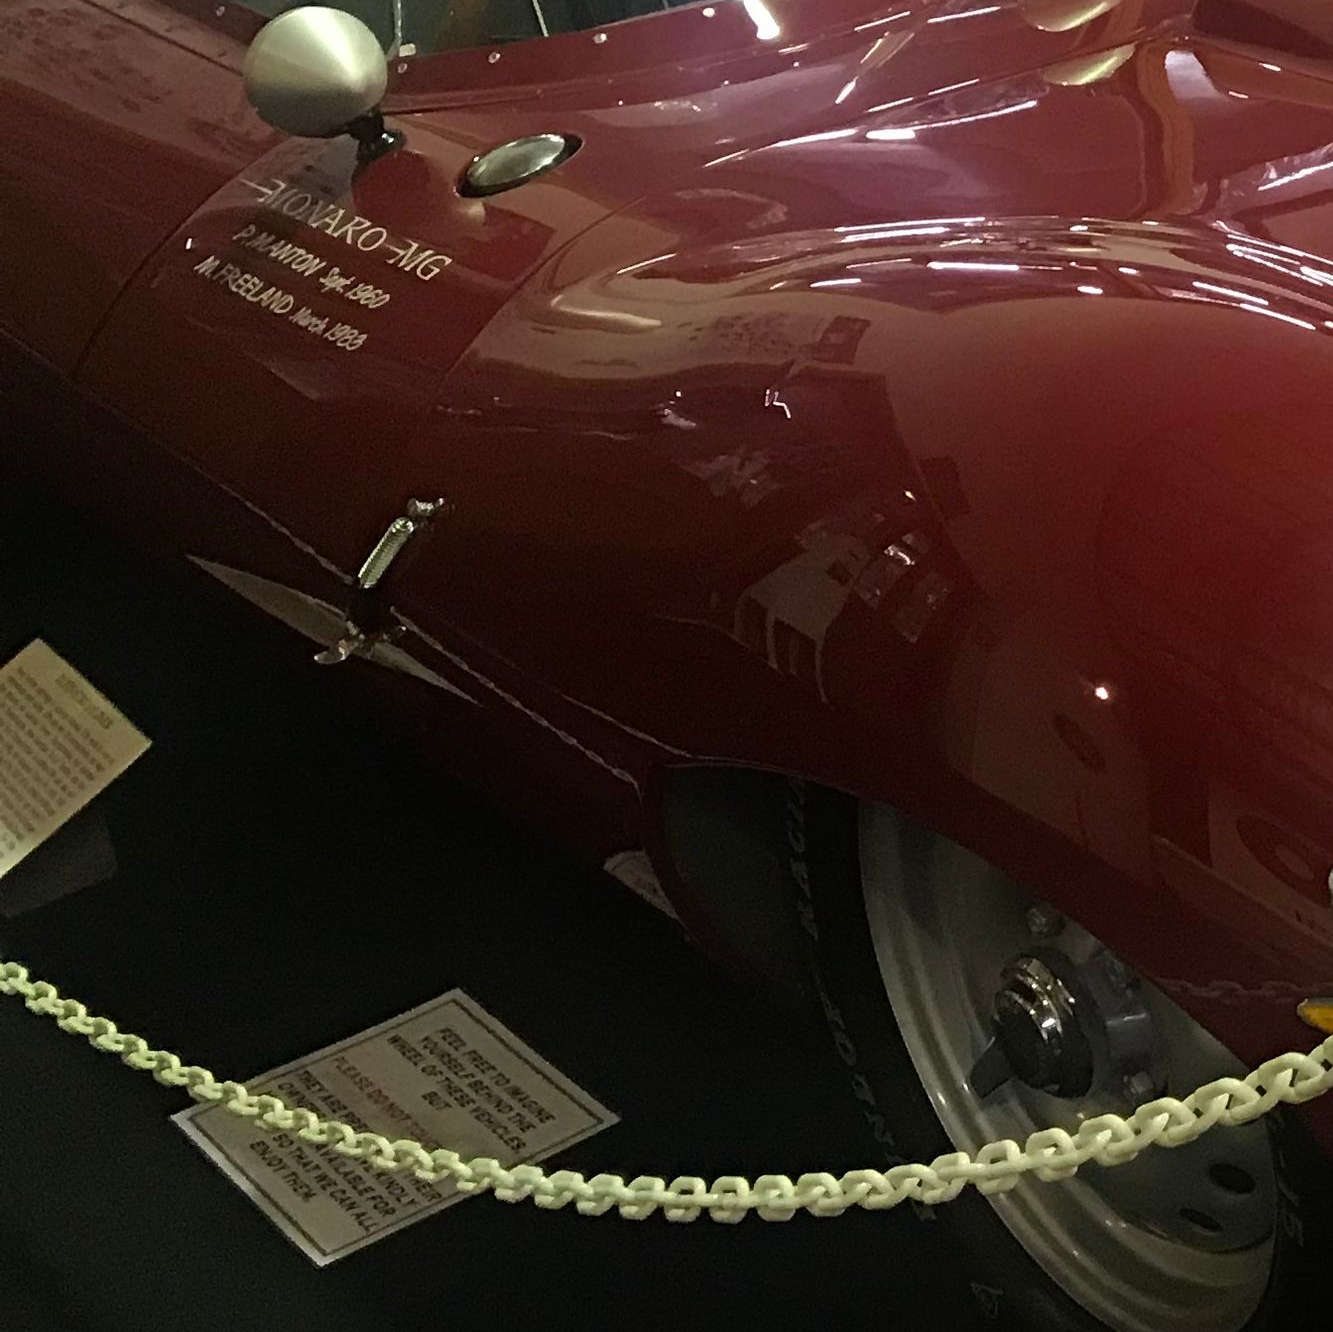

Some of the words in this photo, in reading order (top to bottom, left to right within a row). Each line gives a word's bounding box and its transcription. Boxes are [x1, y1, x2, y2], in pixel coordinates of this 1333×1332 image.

[345, 283, 391, 309] 1960
[294, 1070, 326, 1096] THEY
[319, 1092, 345, 1113] ARE
[330, 1055, 374, 1092] PLEASE
[367, 1088, 390, 1106] DO
[382, 1101, 411, 1124] NOT
[386, 1034, 426, 1066] WHEEL
[420, 1063, 441, 1079] OF
[436, 1077, 474, 1107] THESE
[417, 1036, 473, 1082] YOURSELF
[467, 1078, 512, 1115] BEHIND
[507, 1112, 534, 1133] THE
[436, 1027, 466, 1051] FEEL
[462, 1049, 495, 1075] FREE
[504, 1083, 554, 1124] IMAGINE
[422, 1090, 450, 1112] BUT
[249, 1139, 288, 1173] ENJOY
[271, 1132, 292, 1149] SO
[286, 1147, 318, 1174] THAT
[312, 1171, 336, 1190] WE
[329, 1187, 358, 1212] CAN
[351, 1209, 379, 1232] ALL
[372, 1169, 418, 1208] KINDLY
[366, 1192, 396, 1218] FOR
